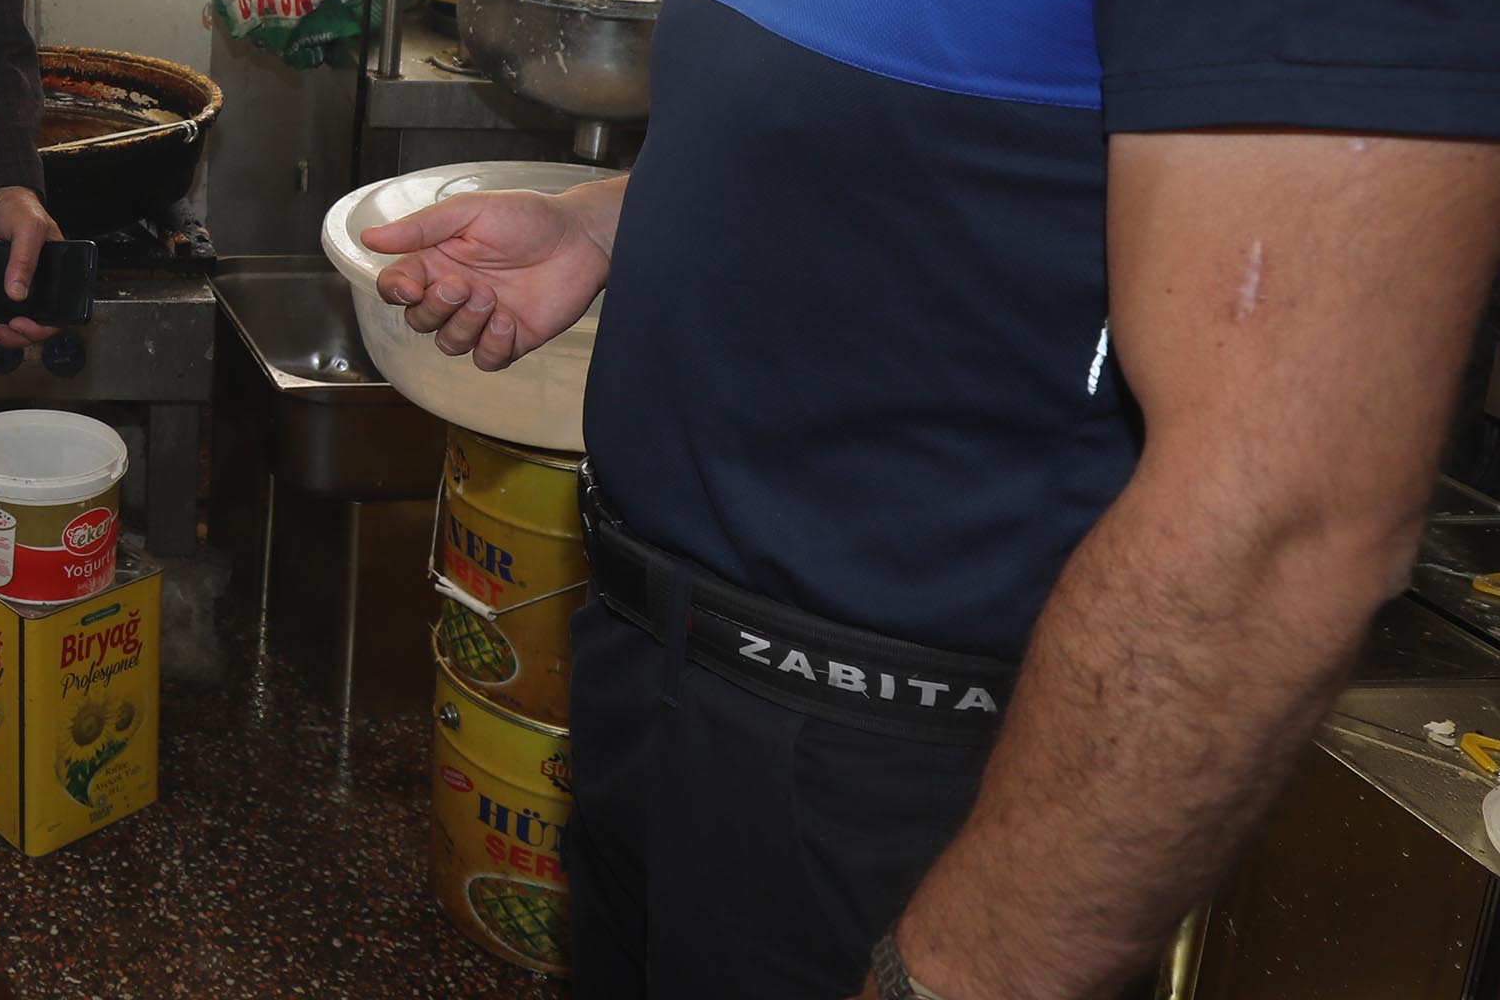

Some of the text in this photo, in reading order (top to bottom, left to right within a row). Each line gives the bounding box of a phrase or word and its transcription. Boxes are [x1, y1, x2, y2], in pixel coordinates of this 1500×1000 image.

[63, 550, 112, 580] Yoğurt
[60, 607, 141, 669] Biryağ
[61, 641, 143, 699] Profesyonel
[738, 631, 998, 713] ZABITA
